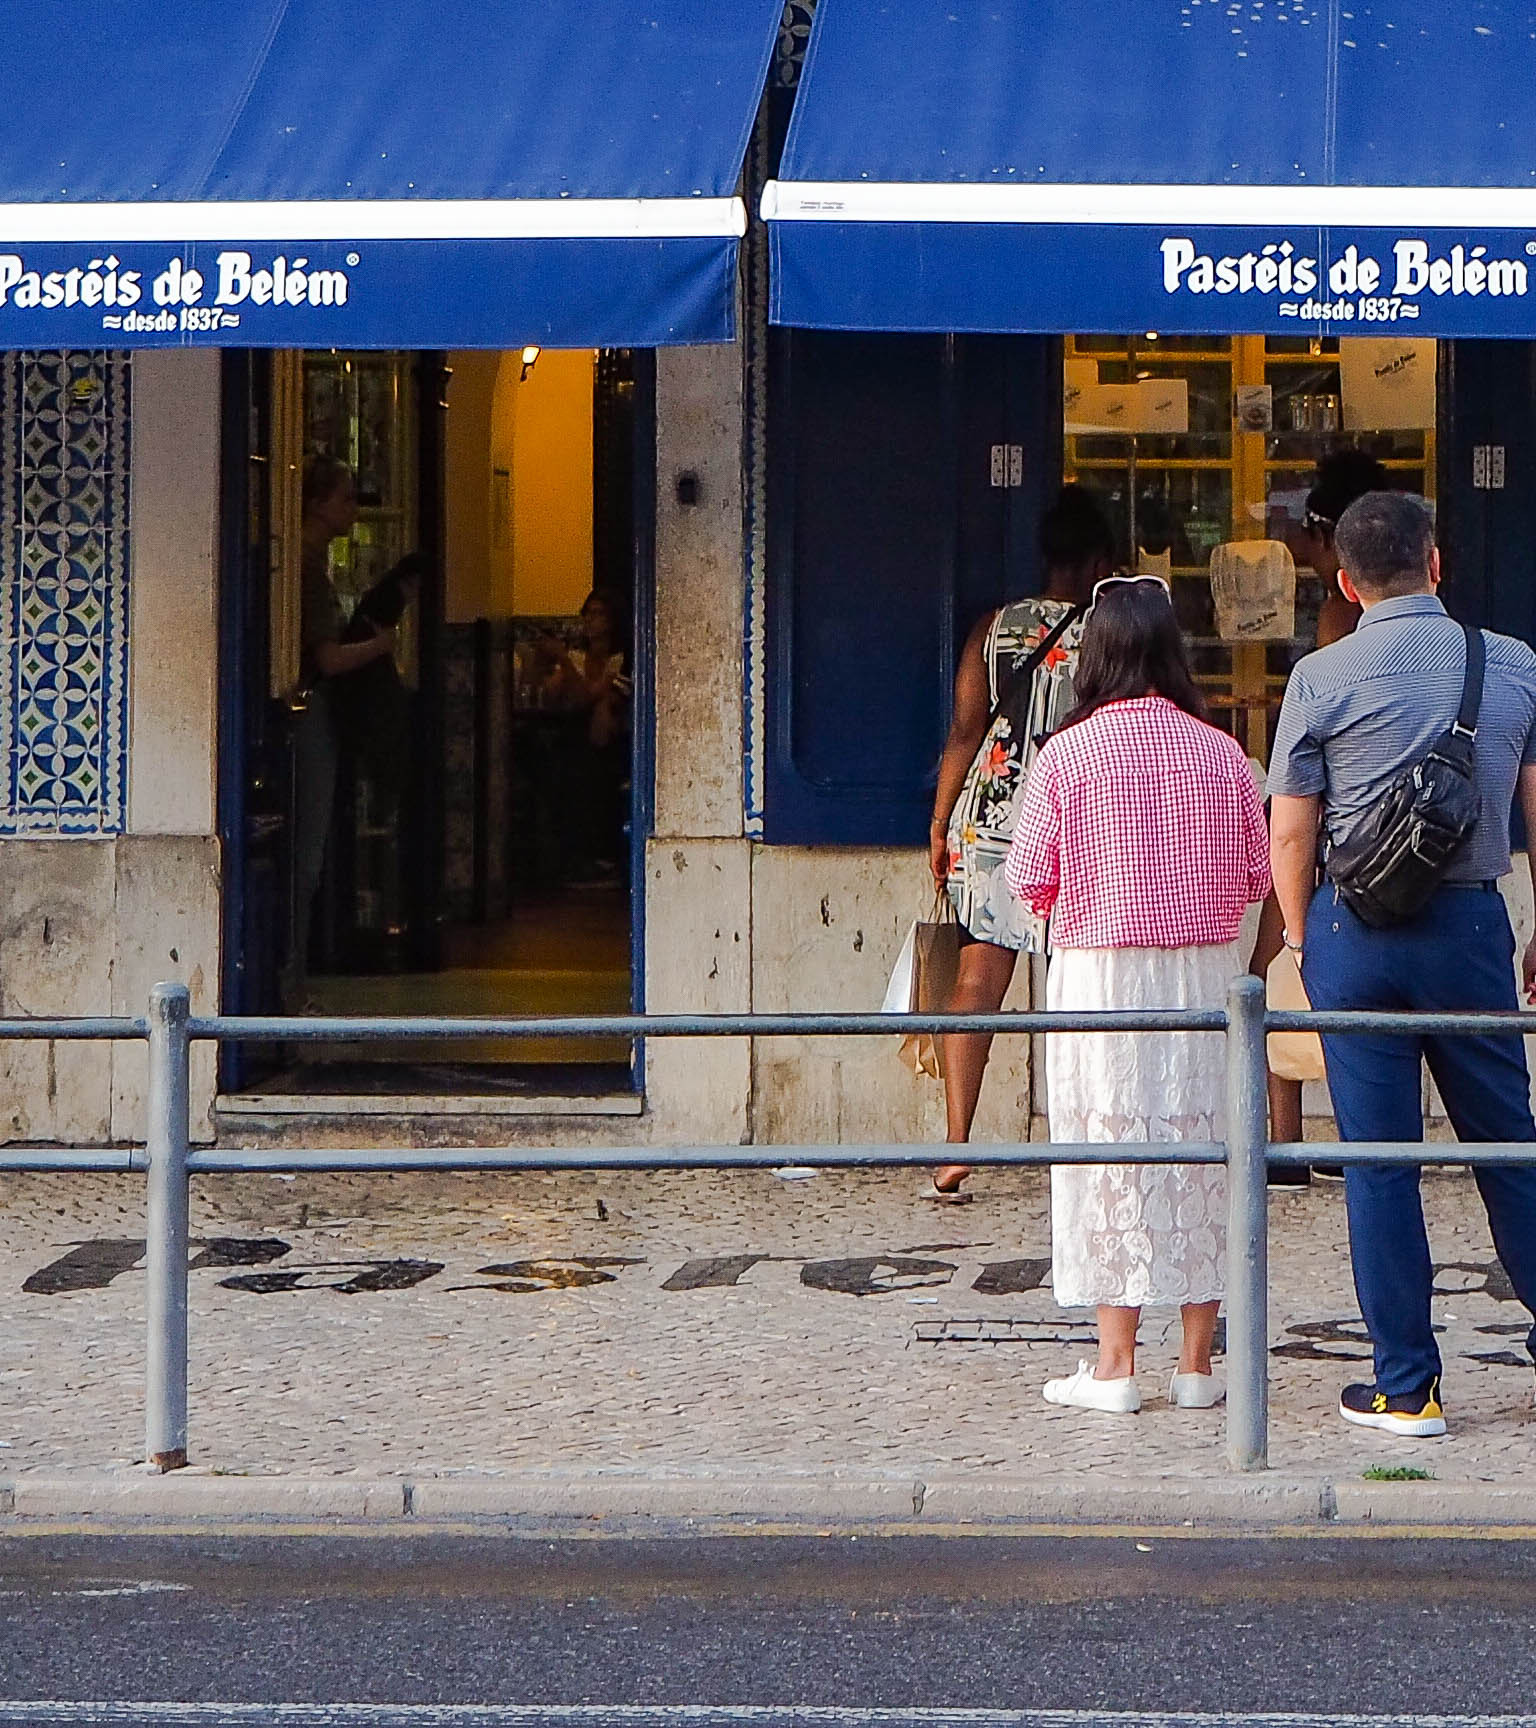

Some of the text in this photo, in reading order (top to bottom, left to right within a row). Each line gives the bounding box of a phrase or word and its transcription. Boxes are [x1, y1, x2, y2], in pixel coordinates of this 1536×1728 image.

[153, 257, 204, 307] de
[1159, 237, 1317, 295] Pastéis
[1328, 244, 1380, 296] de
[122, 307, 224, 332] desde 1837
[1299, 296, 1402, 322] desde 1837
